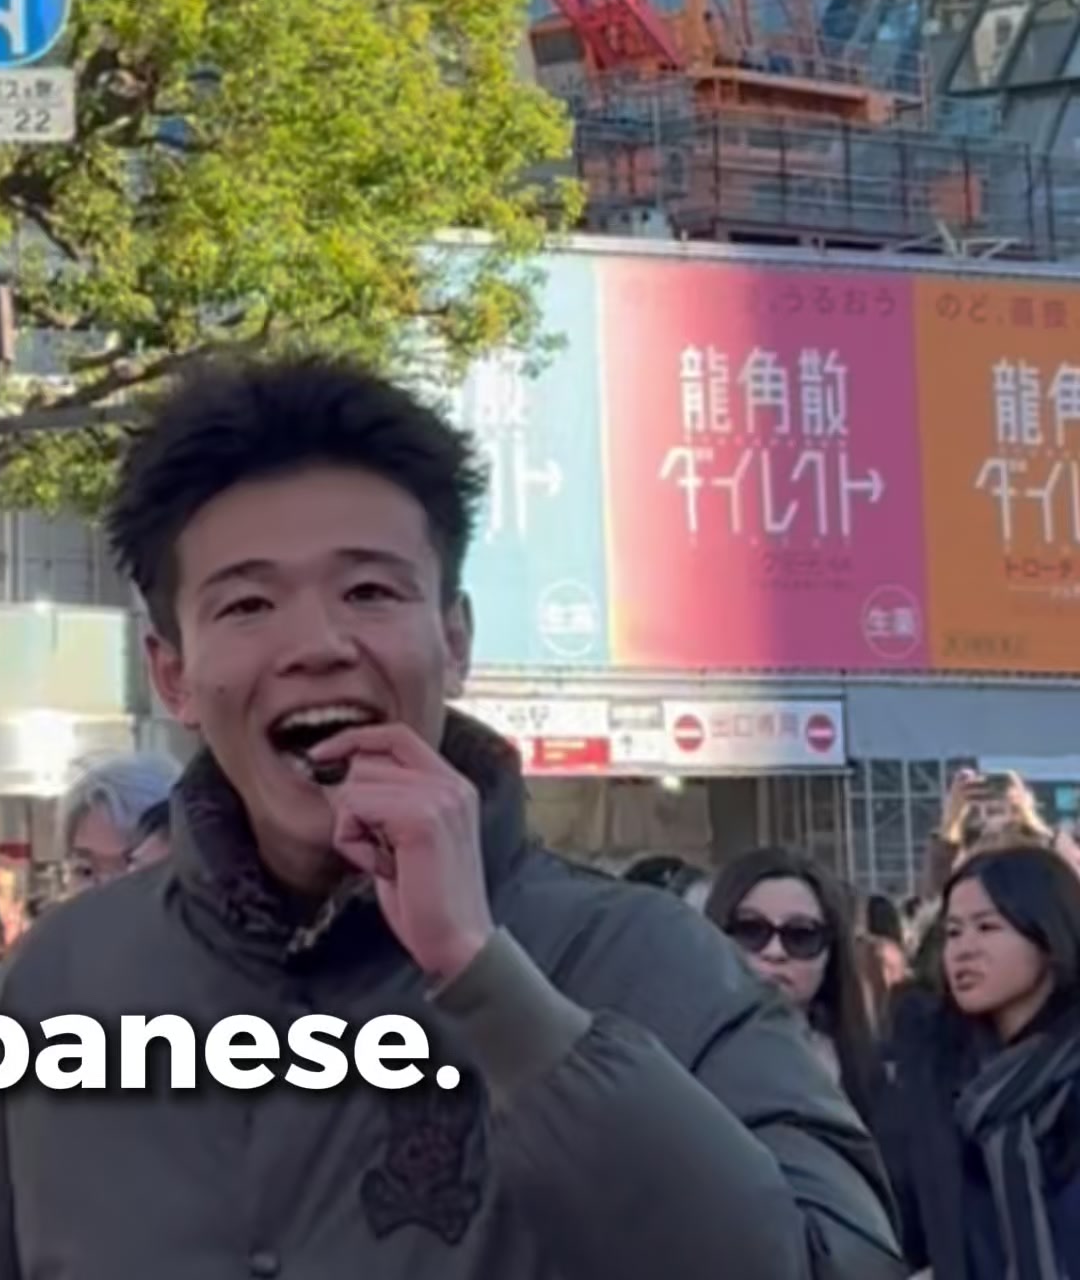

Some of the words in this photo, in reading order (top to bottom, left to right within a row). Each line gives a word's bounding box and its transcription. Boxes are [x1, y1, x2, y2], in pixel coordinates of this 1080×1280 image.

[678, 344, 849, 437] 龍角散
[657, 447, 885, 537] ダイレクト
